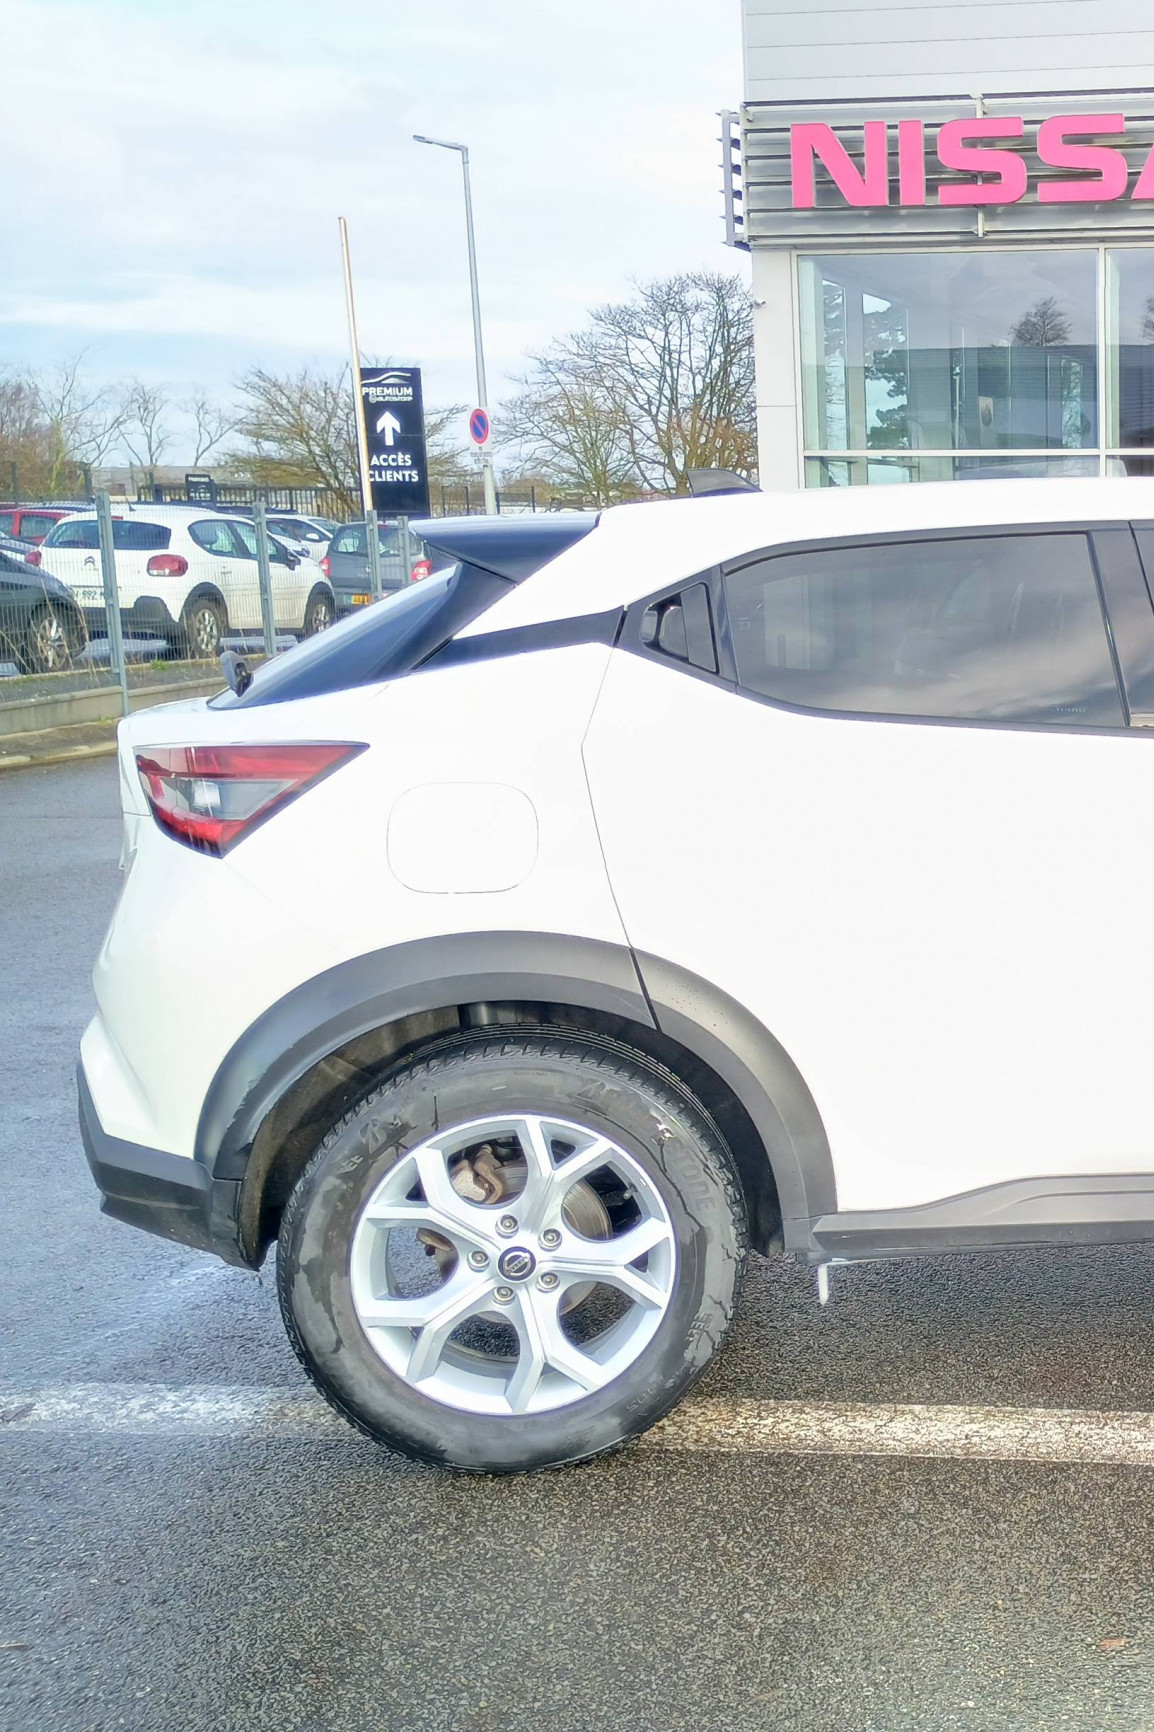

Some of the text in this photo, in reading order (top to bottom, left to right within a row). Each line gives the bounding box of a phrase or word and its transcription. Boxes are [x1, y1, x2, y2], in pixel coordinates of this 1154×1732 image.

[362, 387, 413, 396] PREMIUM
[370, 452, 412, 467] ACCÈS
[369, 471, 419, 482] CLIENTS
